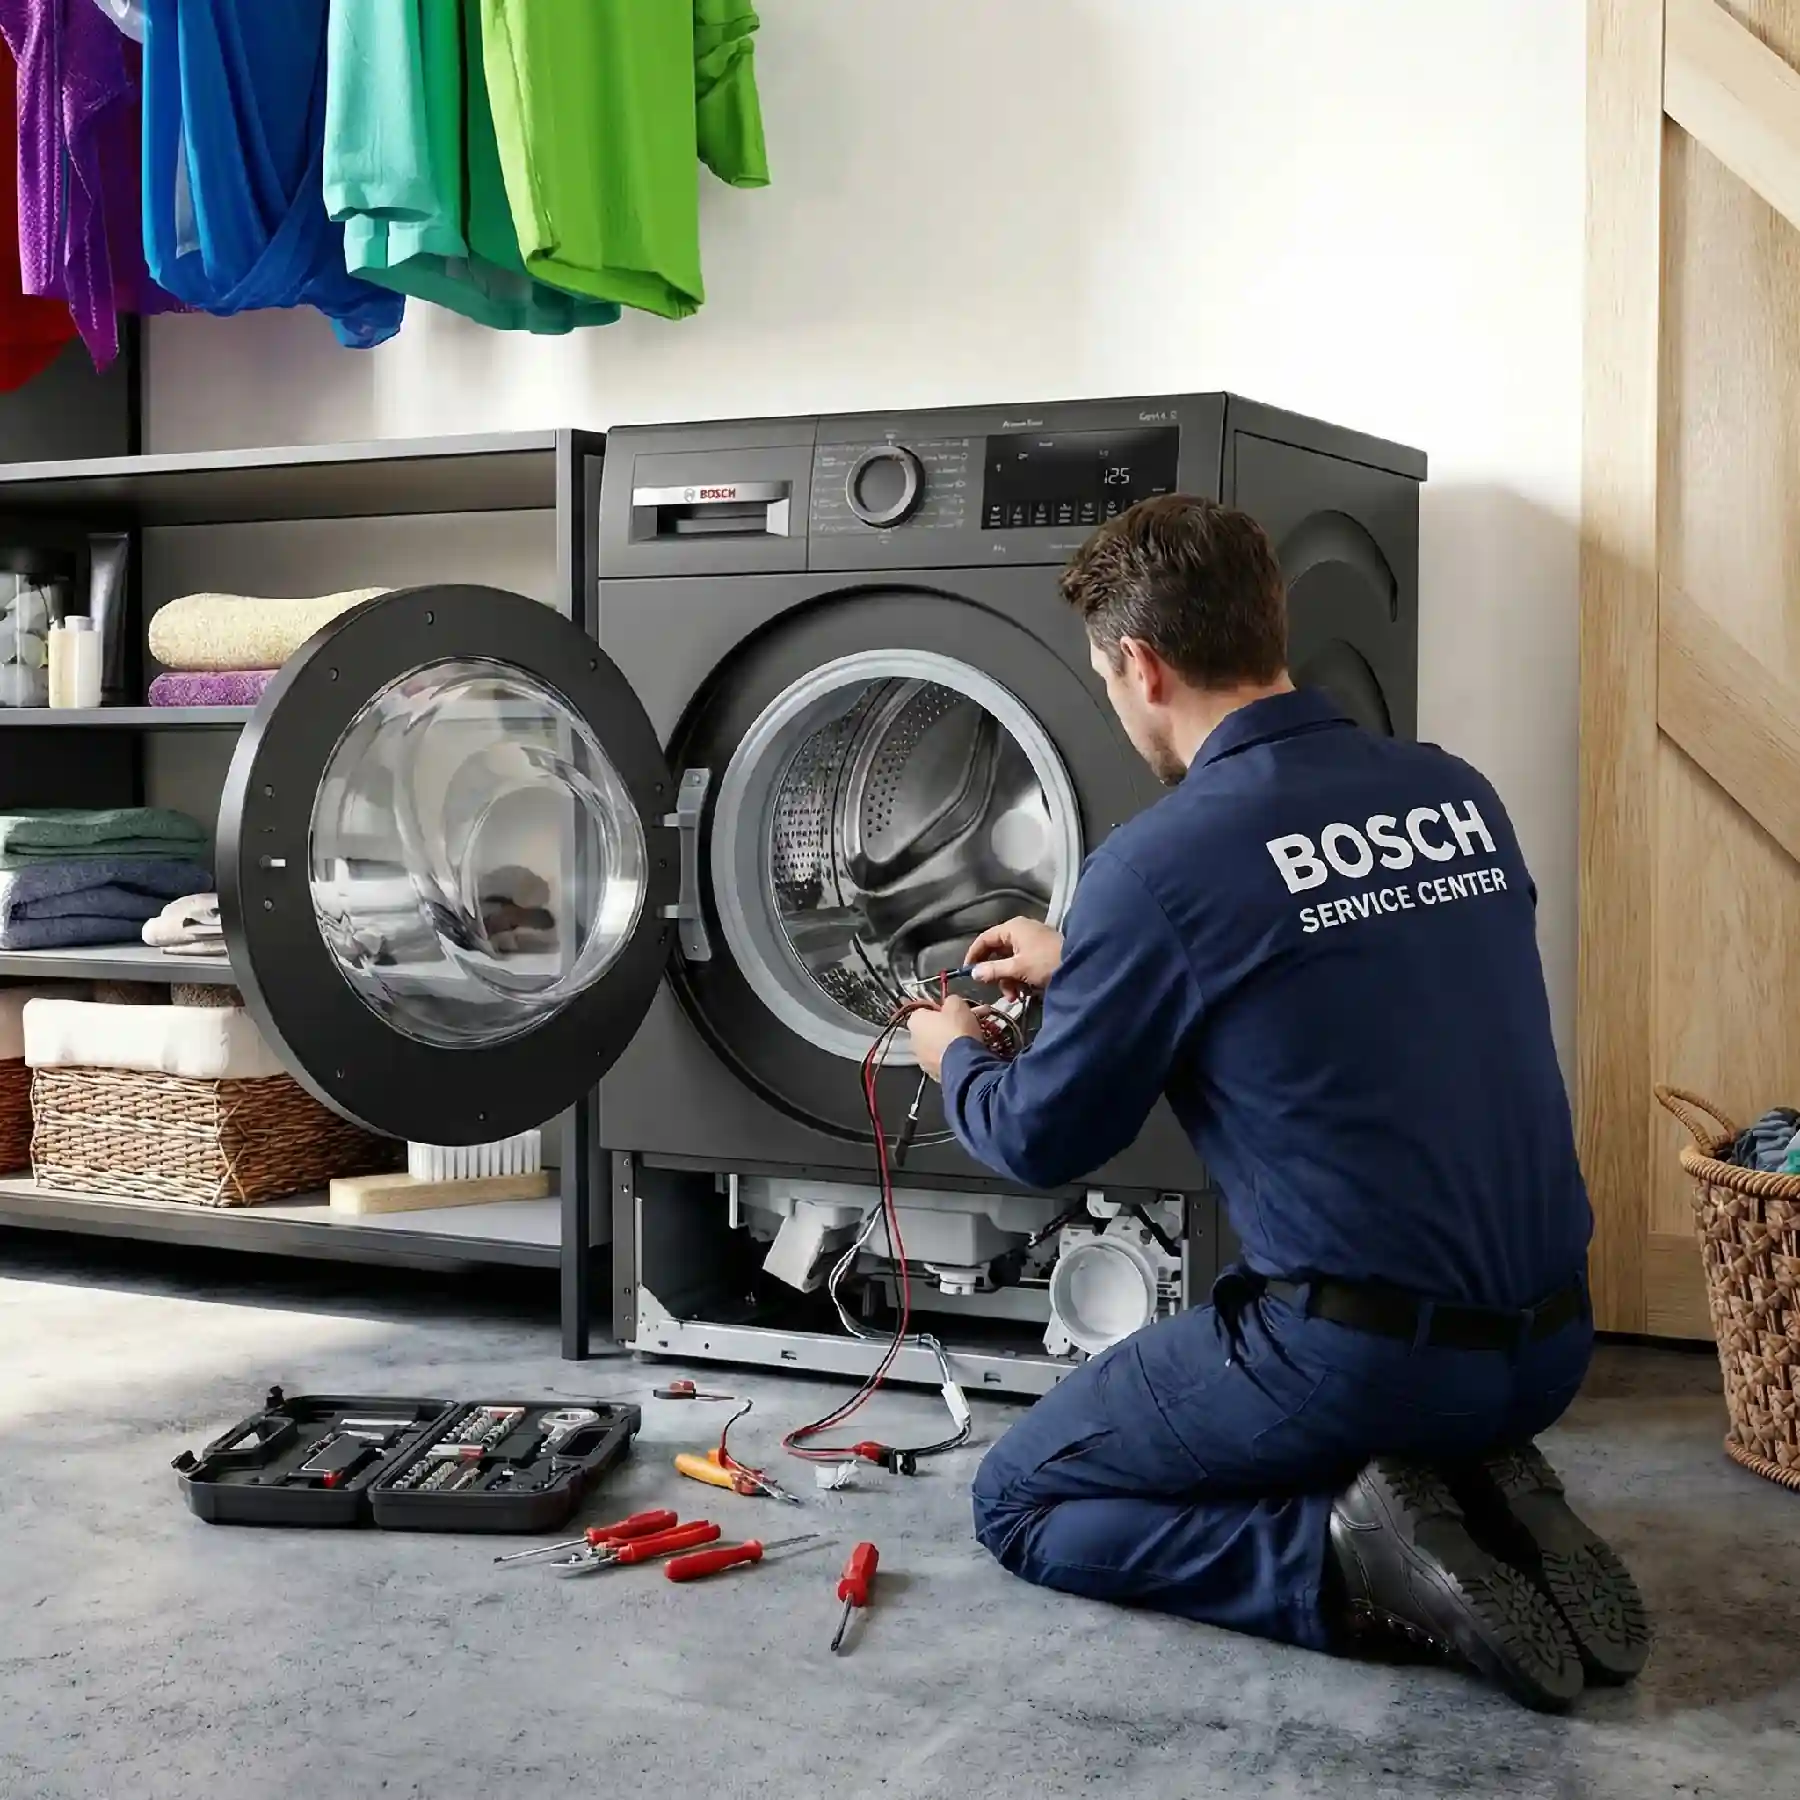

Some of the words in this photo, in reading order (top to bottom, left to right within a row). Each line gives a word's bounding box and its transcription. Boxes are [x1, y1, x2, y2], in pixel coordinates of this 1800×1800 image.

[700, 489, 736, 499] BOSCH
[1104, 467, 1130, 484] 125
[1265, 800, 1497, 894] BOSCH
[1299, 886, 1416, 933] SERVICE
[1417, 867, 1508, 905] CENTER
